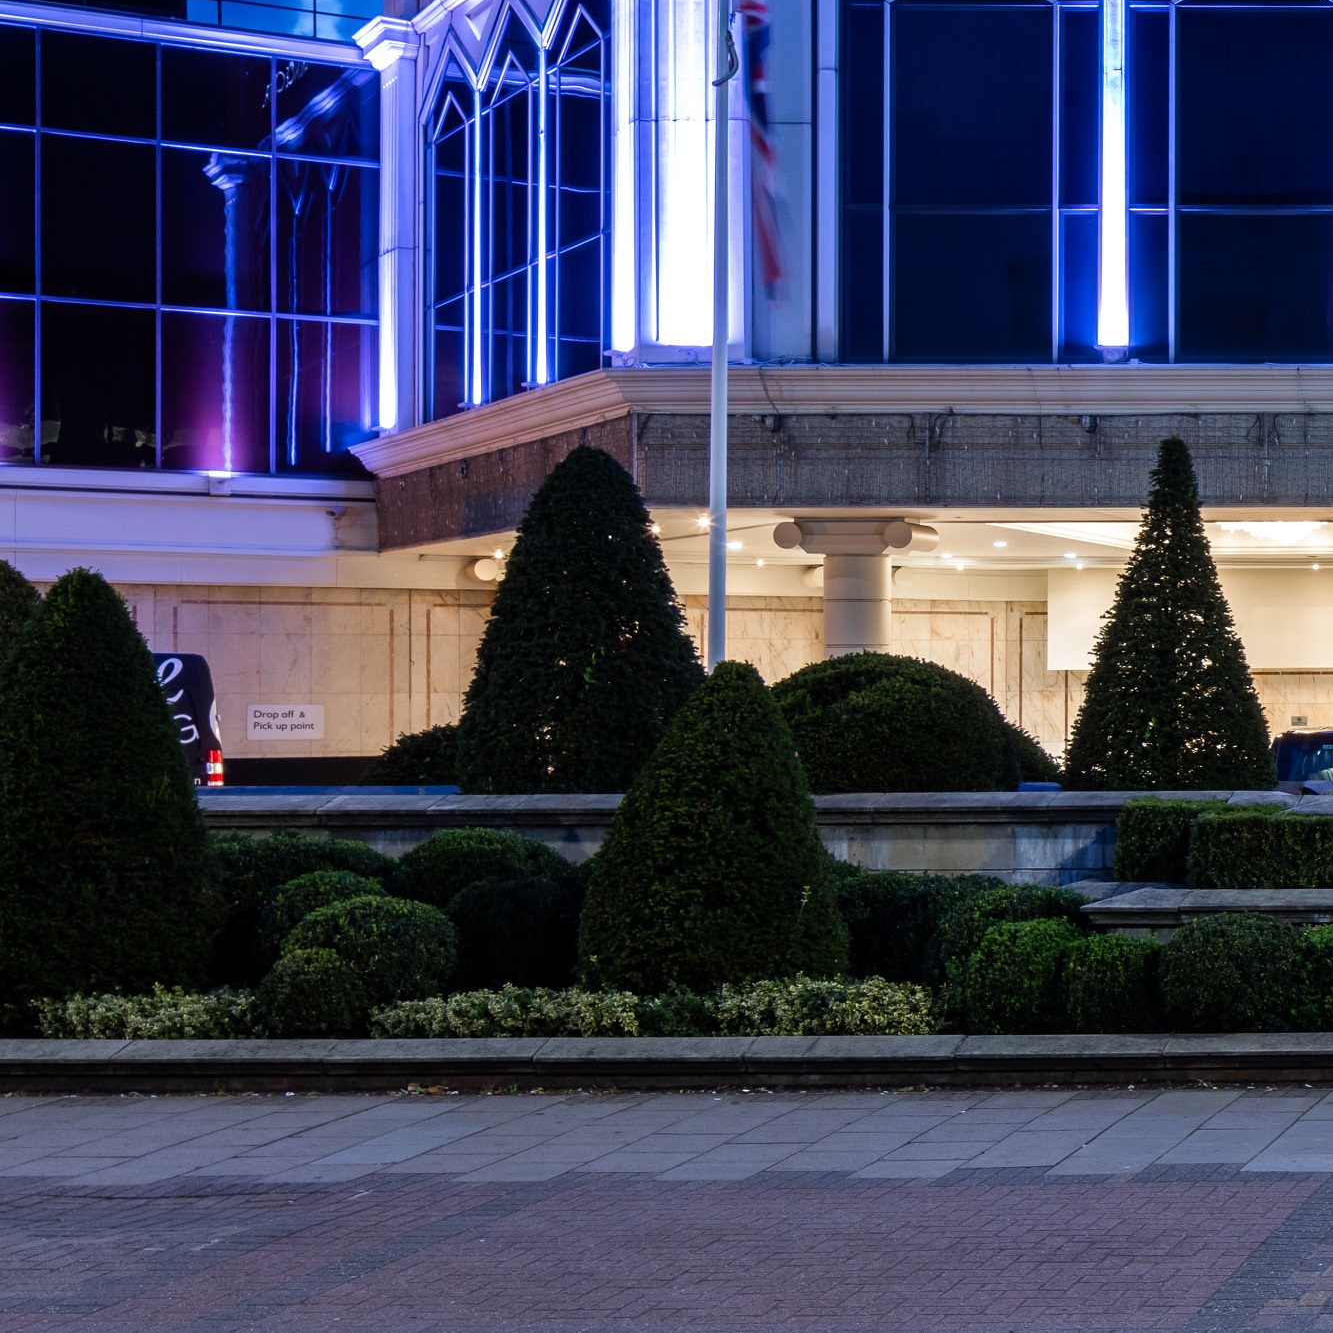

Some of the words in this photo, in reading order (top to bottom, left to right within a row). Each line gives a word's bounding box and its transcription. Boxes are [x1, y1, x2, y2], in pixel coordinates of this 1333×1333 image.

[253, 710, 279, 720] Drop
[281, 710, 295, 719] off
[299, 711, 306, 719] &
[253, 721, 273, 730] Pick
[275, 723, 288, 732] up
[290, 722, 315, 732] point
